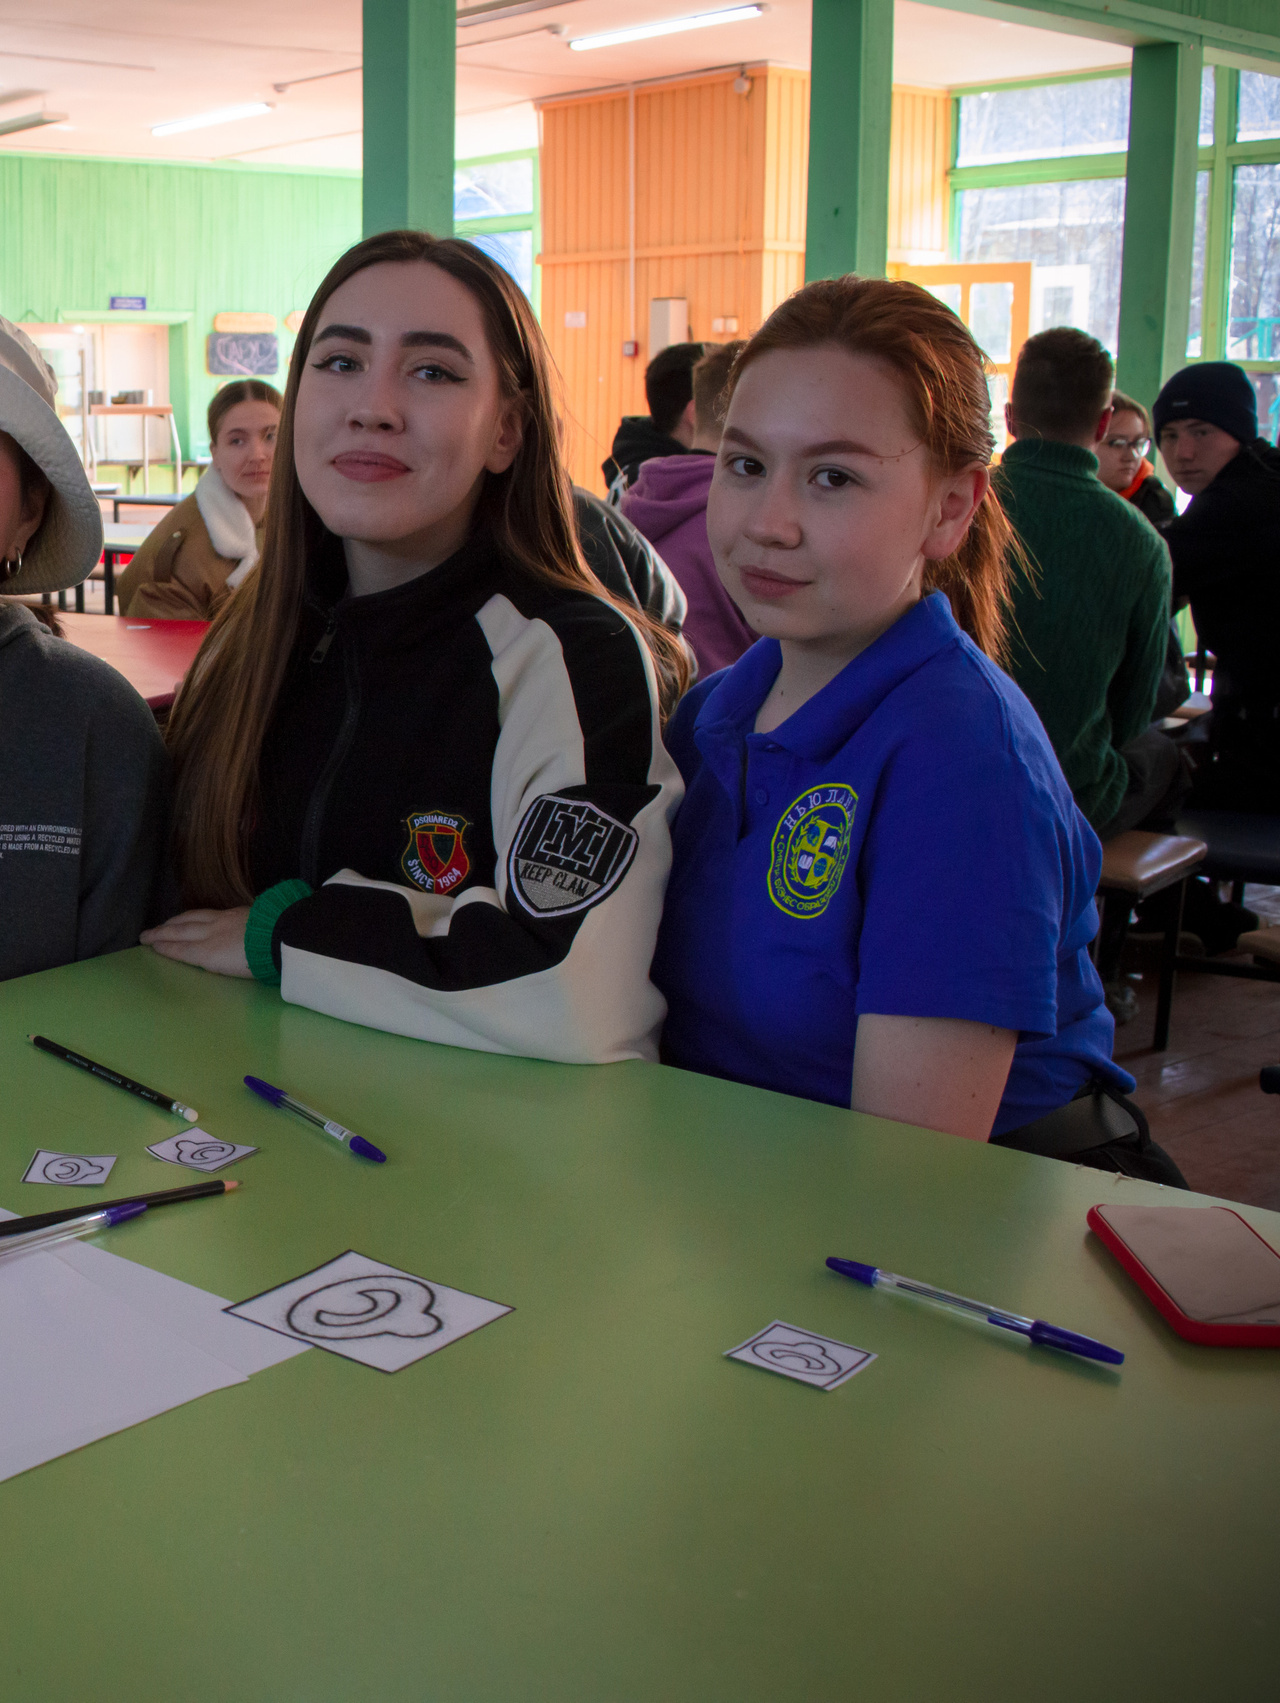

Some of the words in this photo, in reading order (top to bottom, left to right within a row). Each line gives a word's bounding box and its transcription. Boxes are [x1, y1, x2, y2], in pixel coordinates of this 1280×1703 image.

[414, 814, 459, 828] DSQUARED2
[784, 793, 822, 830] НЬЮ
[8, 842, 23, 850] MADE
[24, 842, 39, 851] FROM
[39, 843, 44, 851] A
[44, 844, 70, 854] RECYCLED
[37, 834, 65, 844] RECYCLED
[407, 859, 434, 889] SINCE
[436, 867, 462, 889] 1964
[520, 862, 552, 883] KEEP
[553, 871, 589, 898] CLAM
